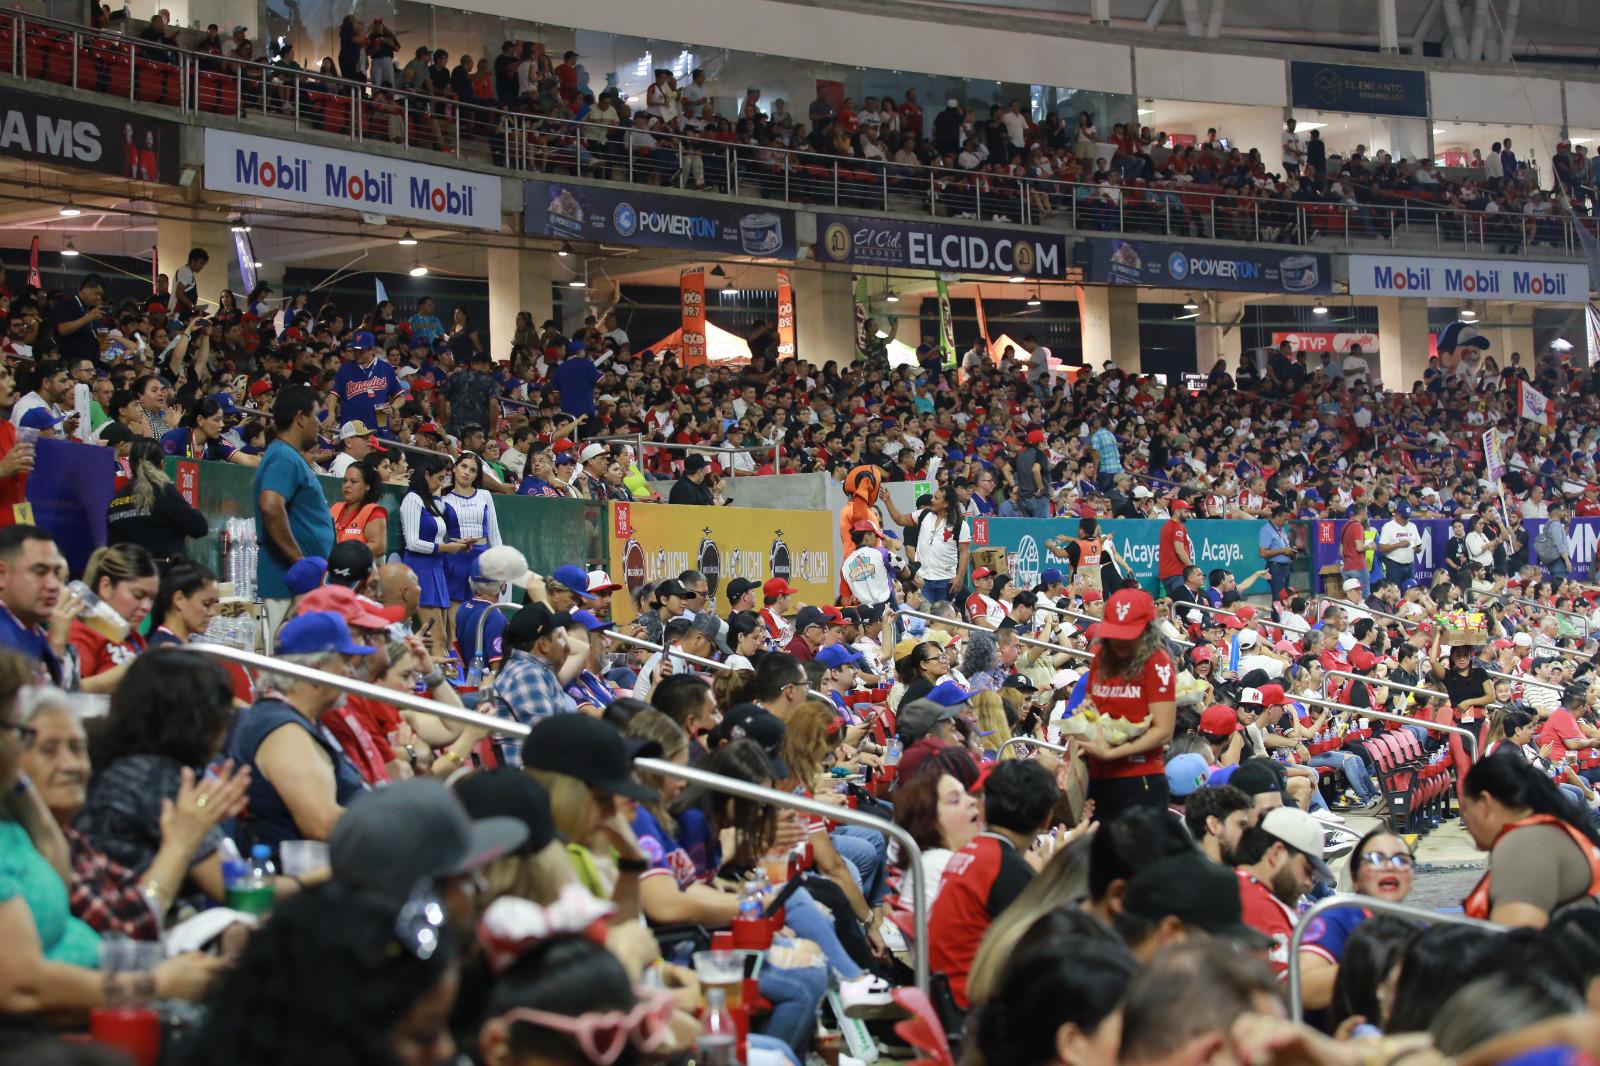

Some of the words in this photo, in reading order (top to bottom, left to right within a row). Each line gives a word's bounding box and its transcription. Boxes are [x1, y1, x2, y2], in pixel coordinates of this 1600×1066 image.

[0, 110, 102, 162] AMS
[236, 149, 307, 193] Mobil
[325, 163, 393, 205] Mobil
[410, 176, 473, 217] Mobil
[1374, 265, 1430, 291] Mobil
[1445, 268, 1499, 293] Mobil
[1512, 271, 1566, 295] Mobil
[1300, 337, 1327, 350] TVP
[1201, 537, 1243, 567] Acaya.
